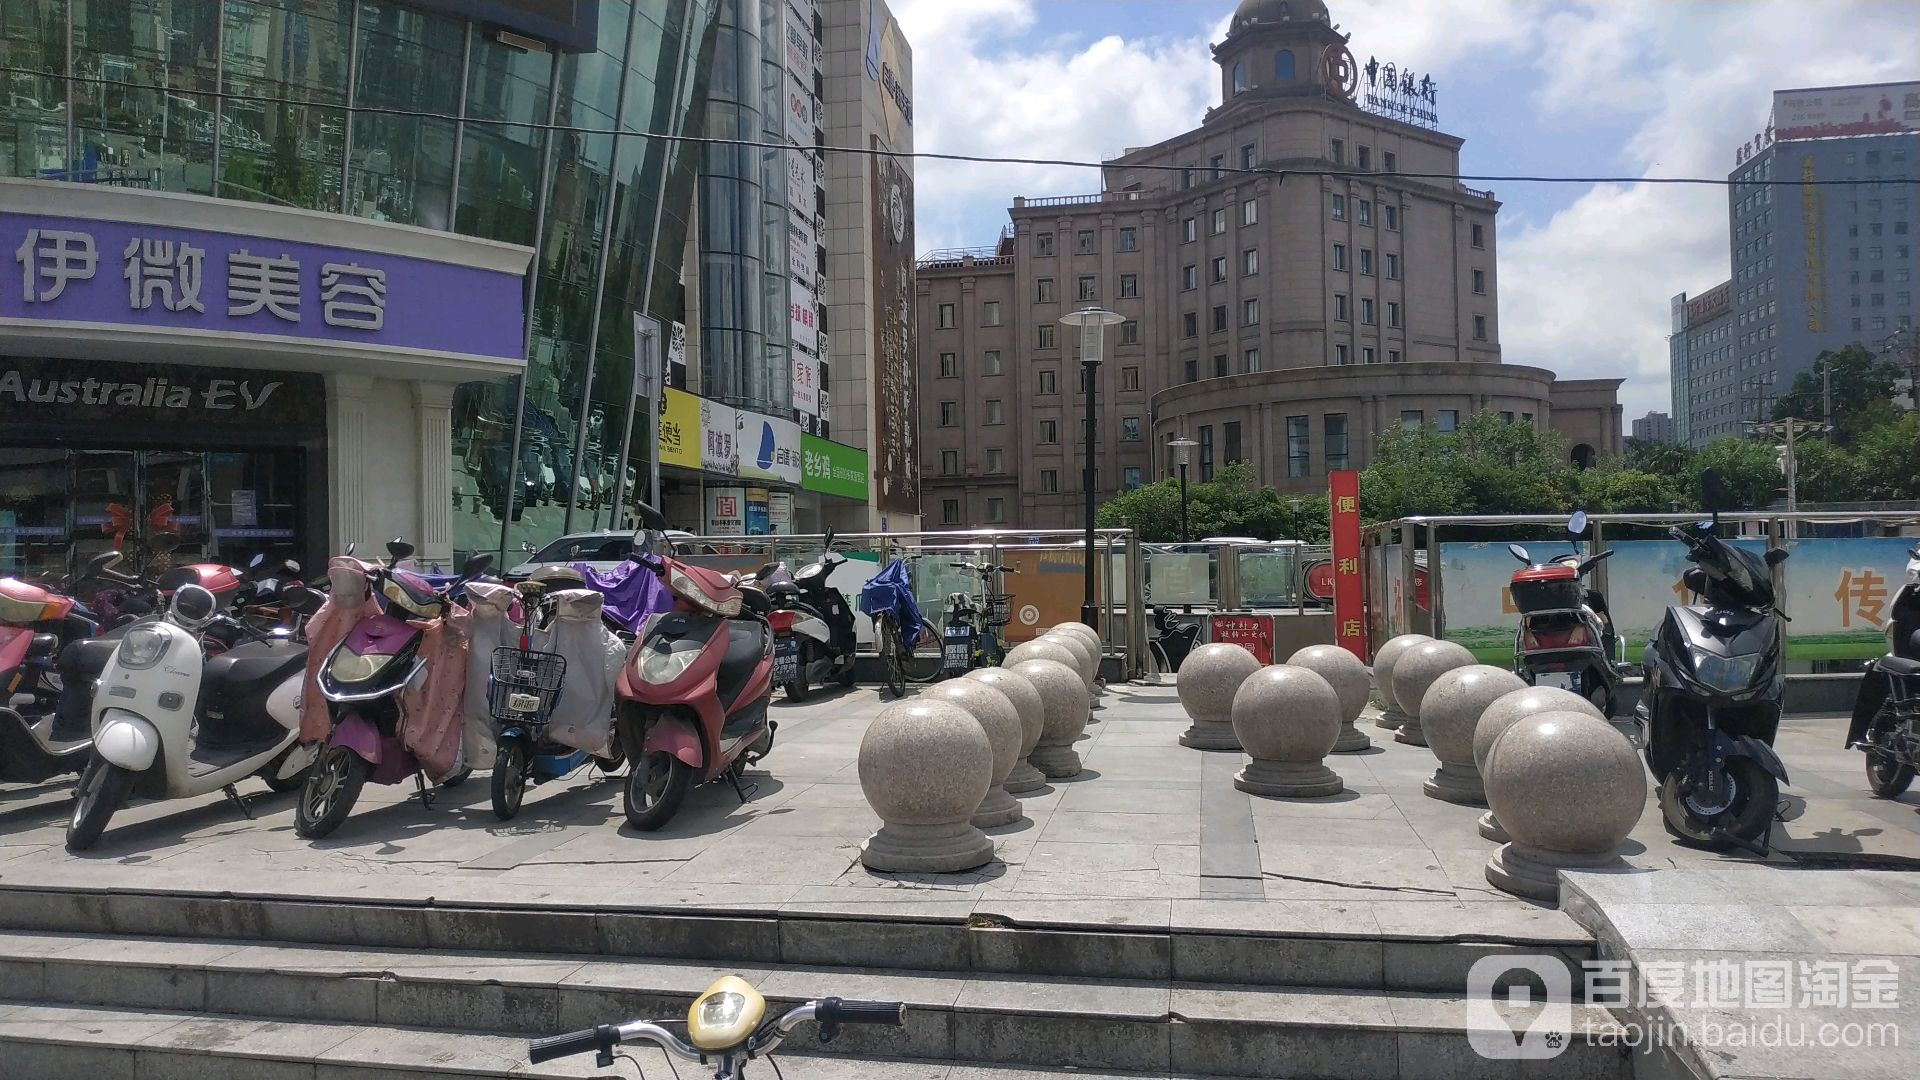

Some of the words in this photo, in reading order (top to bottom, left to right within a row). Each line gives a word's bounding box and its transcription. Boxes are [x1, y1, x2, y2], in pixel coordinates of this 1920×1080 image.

[1365, 55, 1438, 106] 中国银行
[16, 228, 387, 330] 伊微美容
[0, 370, 191, 410] Australia
[201, 380, 285, 411] EV
[805, 448, 831, 480] 老乡鸡
[1336, 495, 1361, 638] 便利店
